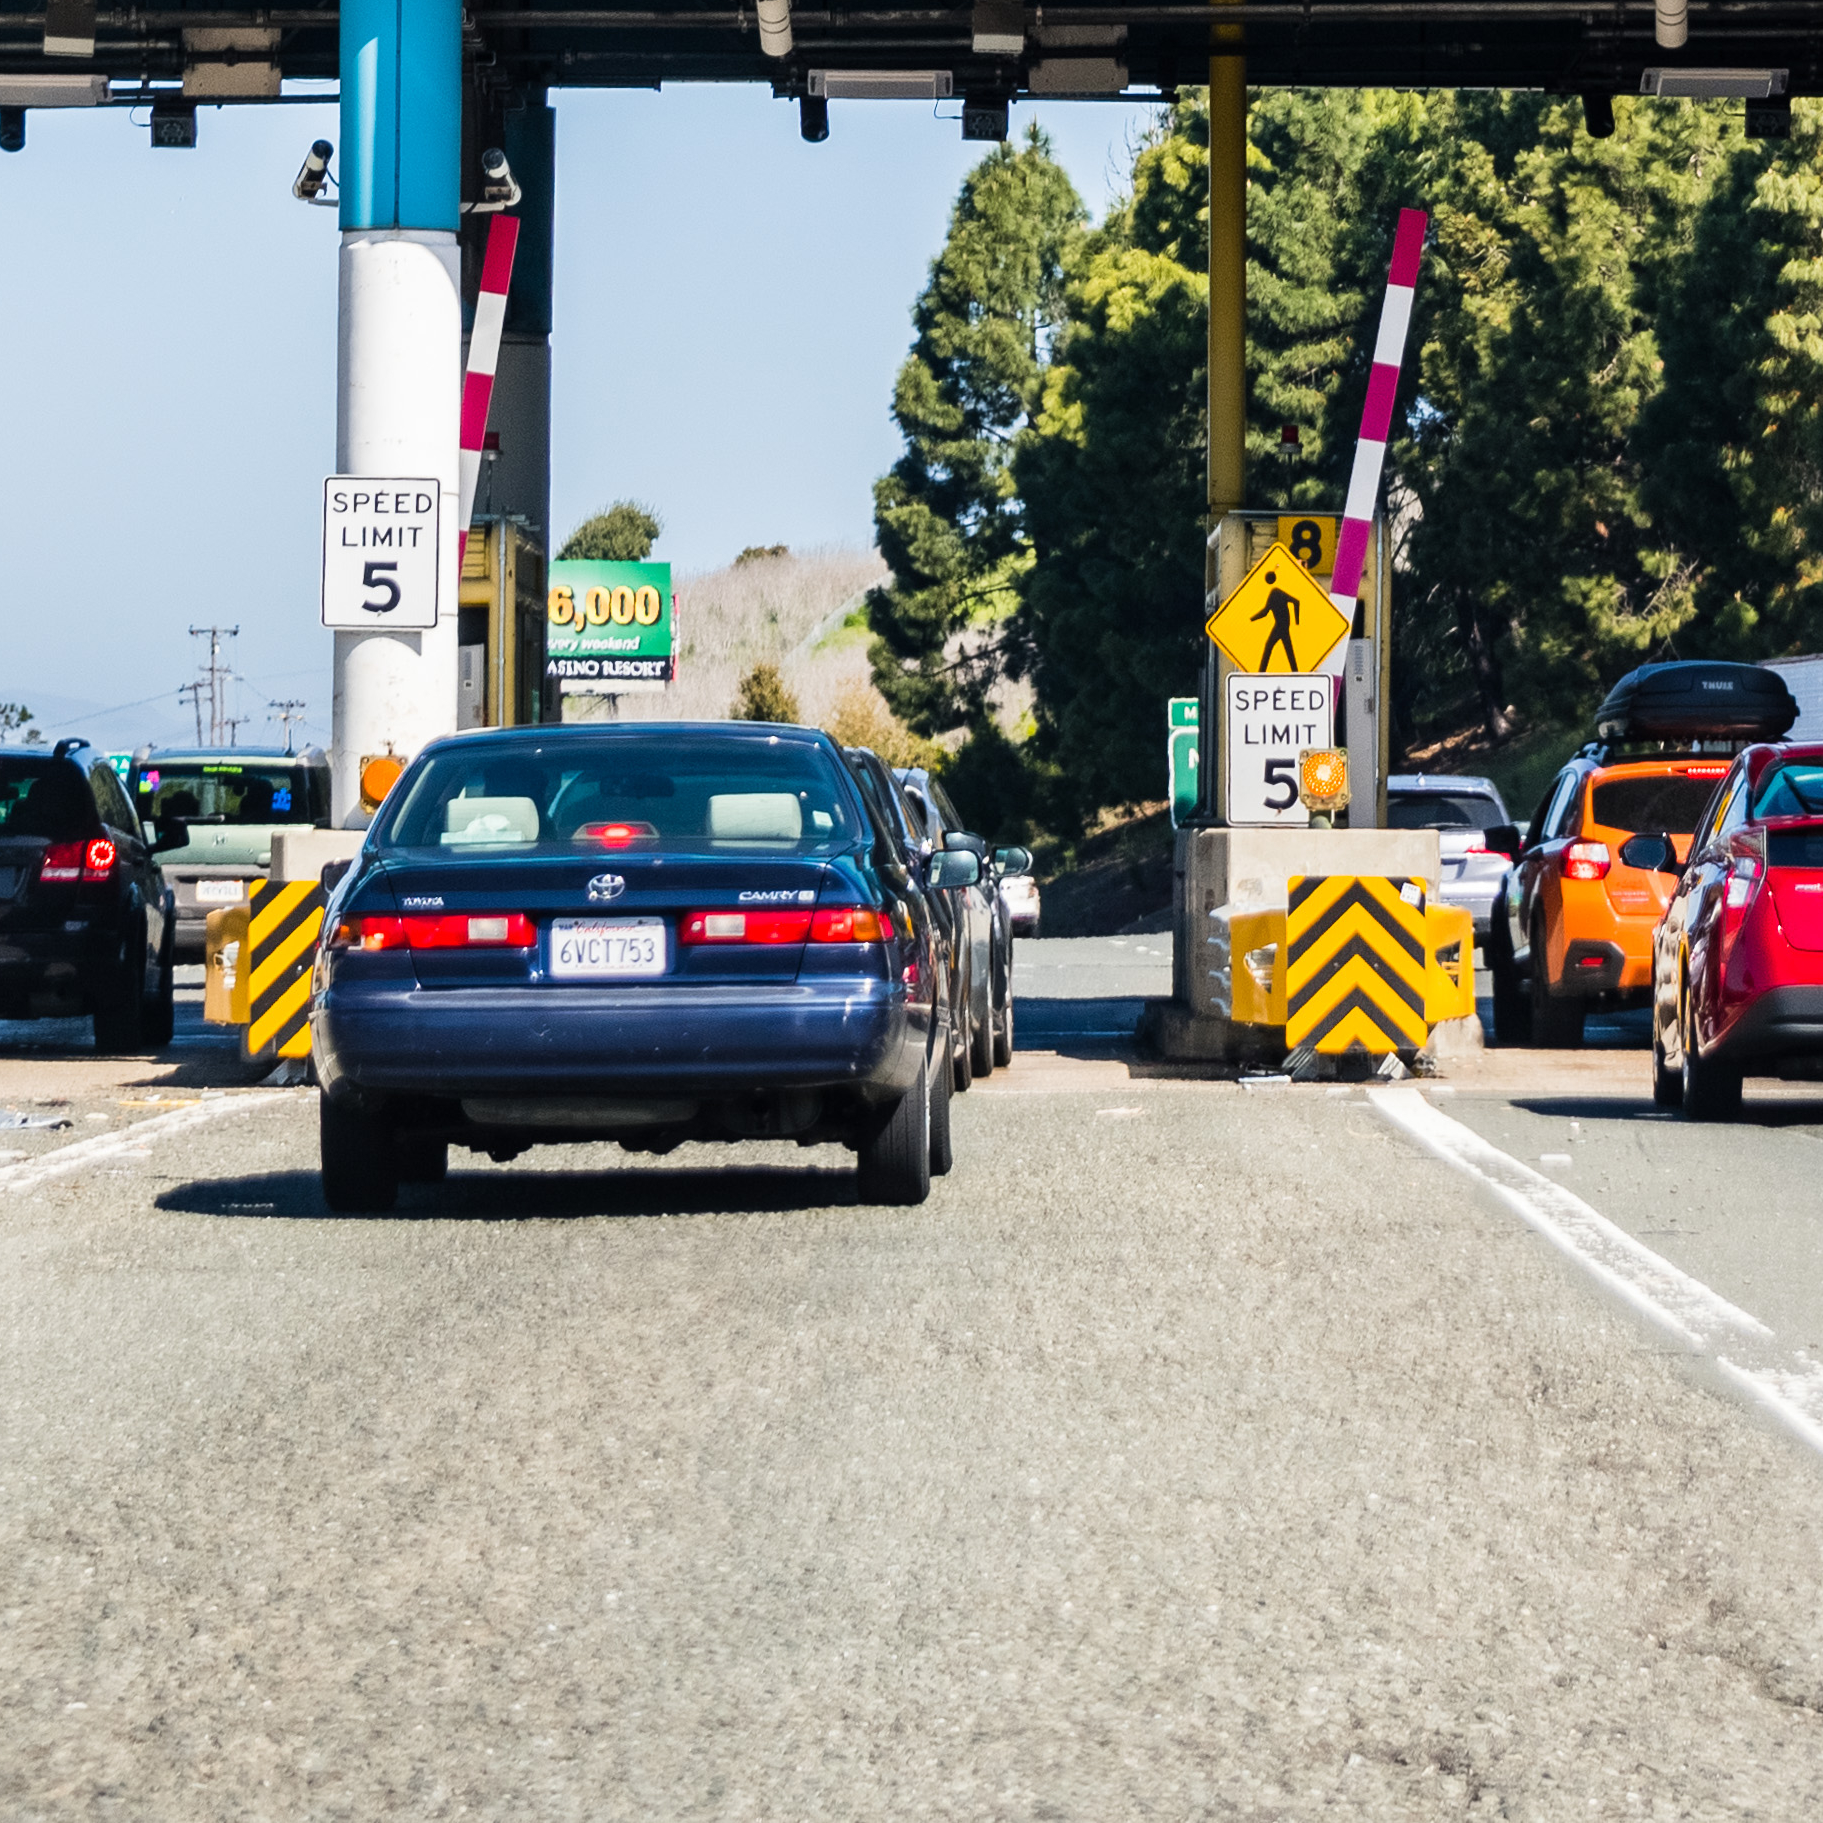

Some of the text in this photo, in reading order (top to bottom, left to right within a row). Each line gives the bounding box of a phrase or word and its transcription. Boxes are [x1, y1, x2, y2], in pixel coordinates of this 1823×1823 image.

[333, 492, 432, 513] SPEED
[342, 527, 423, 547] LIMIT
[1289, 520, 1322, 569] 8
[361, 561, 401, 613] 5
[581, 636, 641, 651] weekend
[602, 660, 665, 676] RESORT
[1235, 690, 1325, 711] SPEED
[1244, 724, 1317, 745] LIMIT
[1263, 758, 1299, 810] 5
[739, 890, 798, 901] CAMRY
[560, 938, 655, 964] 6VCT753
